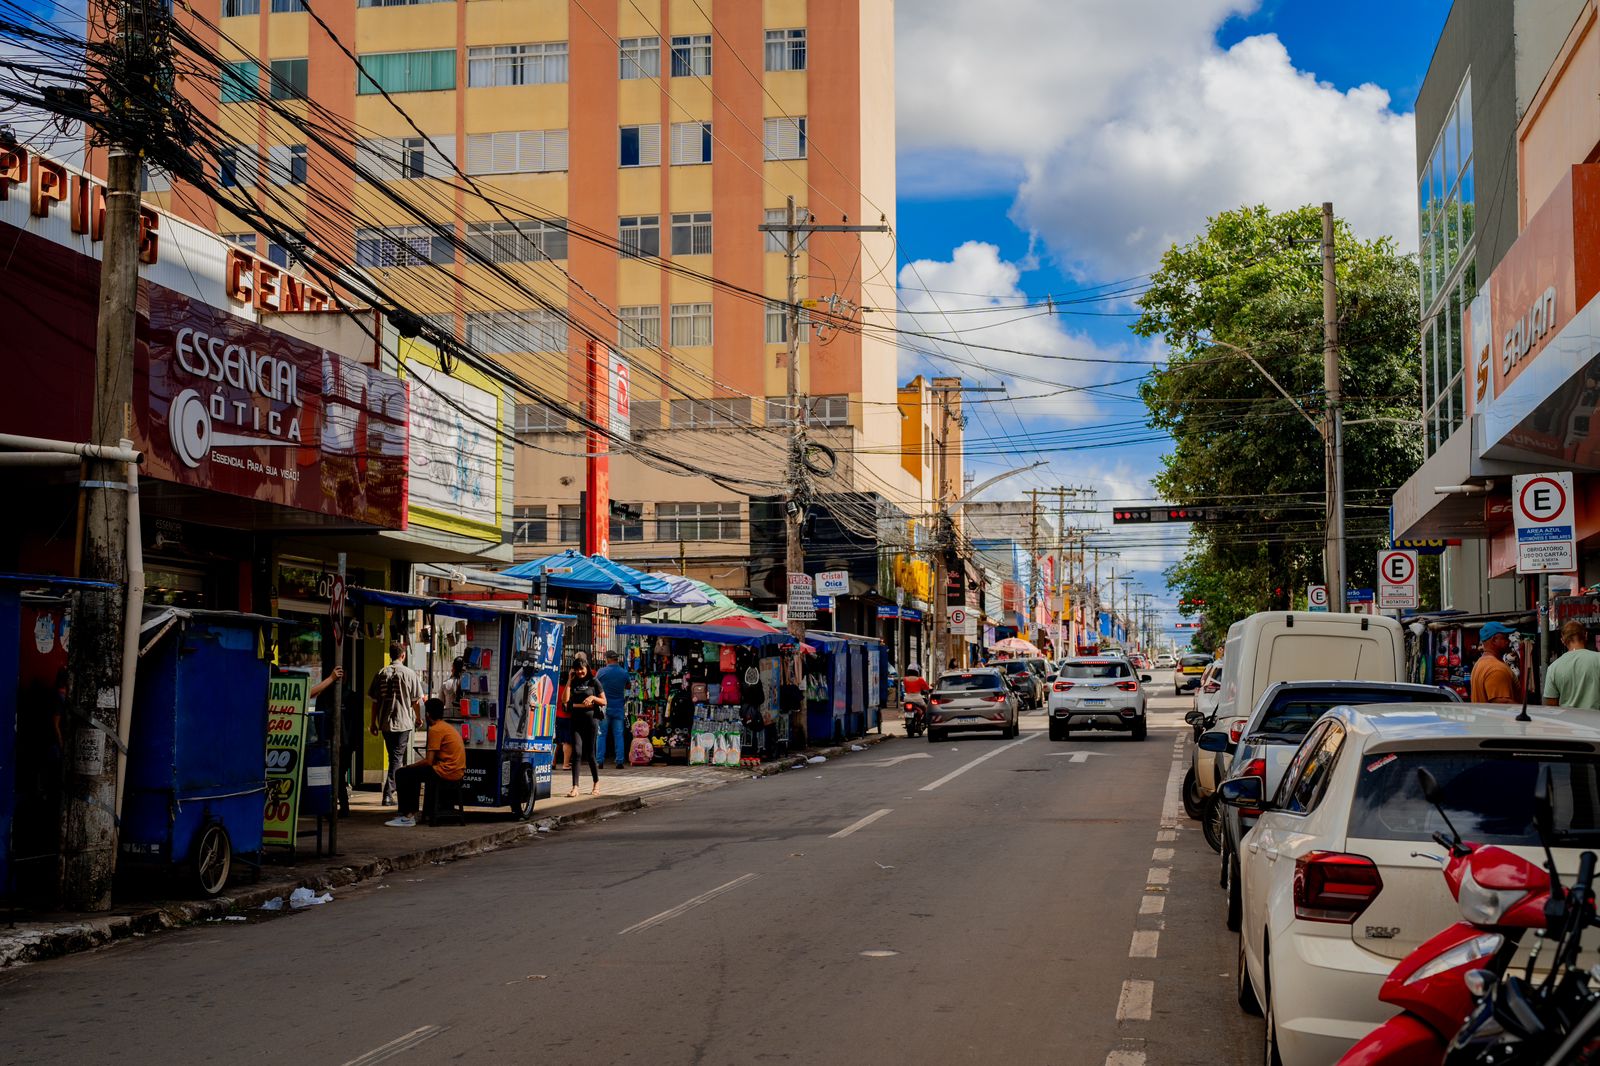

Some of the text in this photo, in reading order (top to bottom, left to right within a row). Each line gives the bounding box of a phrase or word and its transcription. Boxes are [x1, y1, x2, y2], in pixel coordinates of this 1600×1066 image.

[0, 143, 159, 264] PPIG
[226, 247, 337, 311] CENT
[176, 328, 303, 408] ESSENCIAL
[210, 386, 301, 442] ÓTICA
[266, 465, 278, 476] SUA
[1534, 489, 1551, 511] E
[821, 572, 843, 580] Cristal
[1392, 559, 1404, 578] E
[1316, 591, 1323, 600] E
[955, 613, 961, 621] E
[269, 682, 302, 701] ARIA
[535, 765, 547, 774] CAPAS
[536, 774, 551, 783] ELÍCULAS
[1366, 926, 1400, 935] POLO
